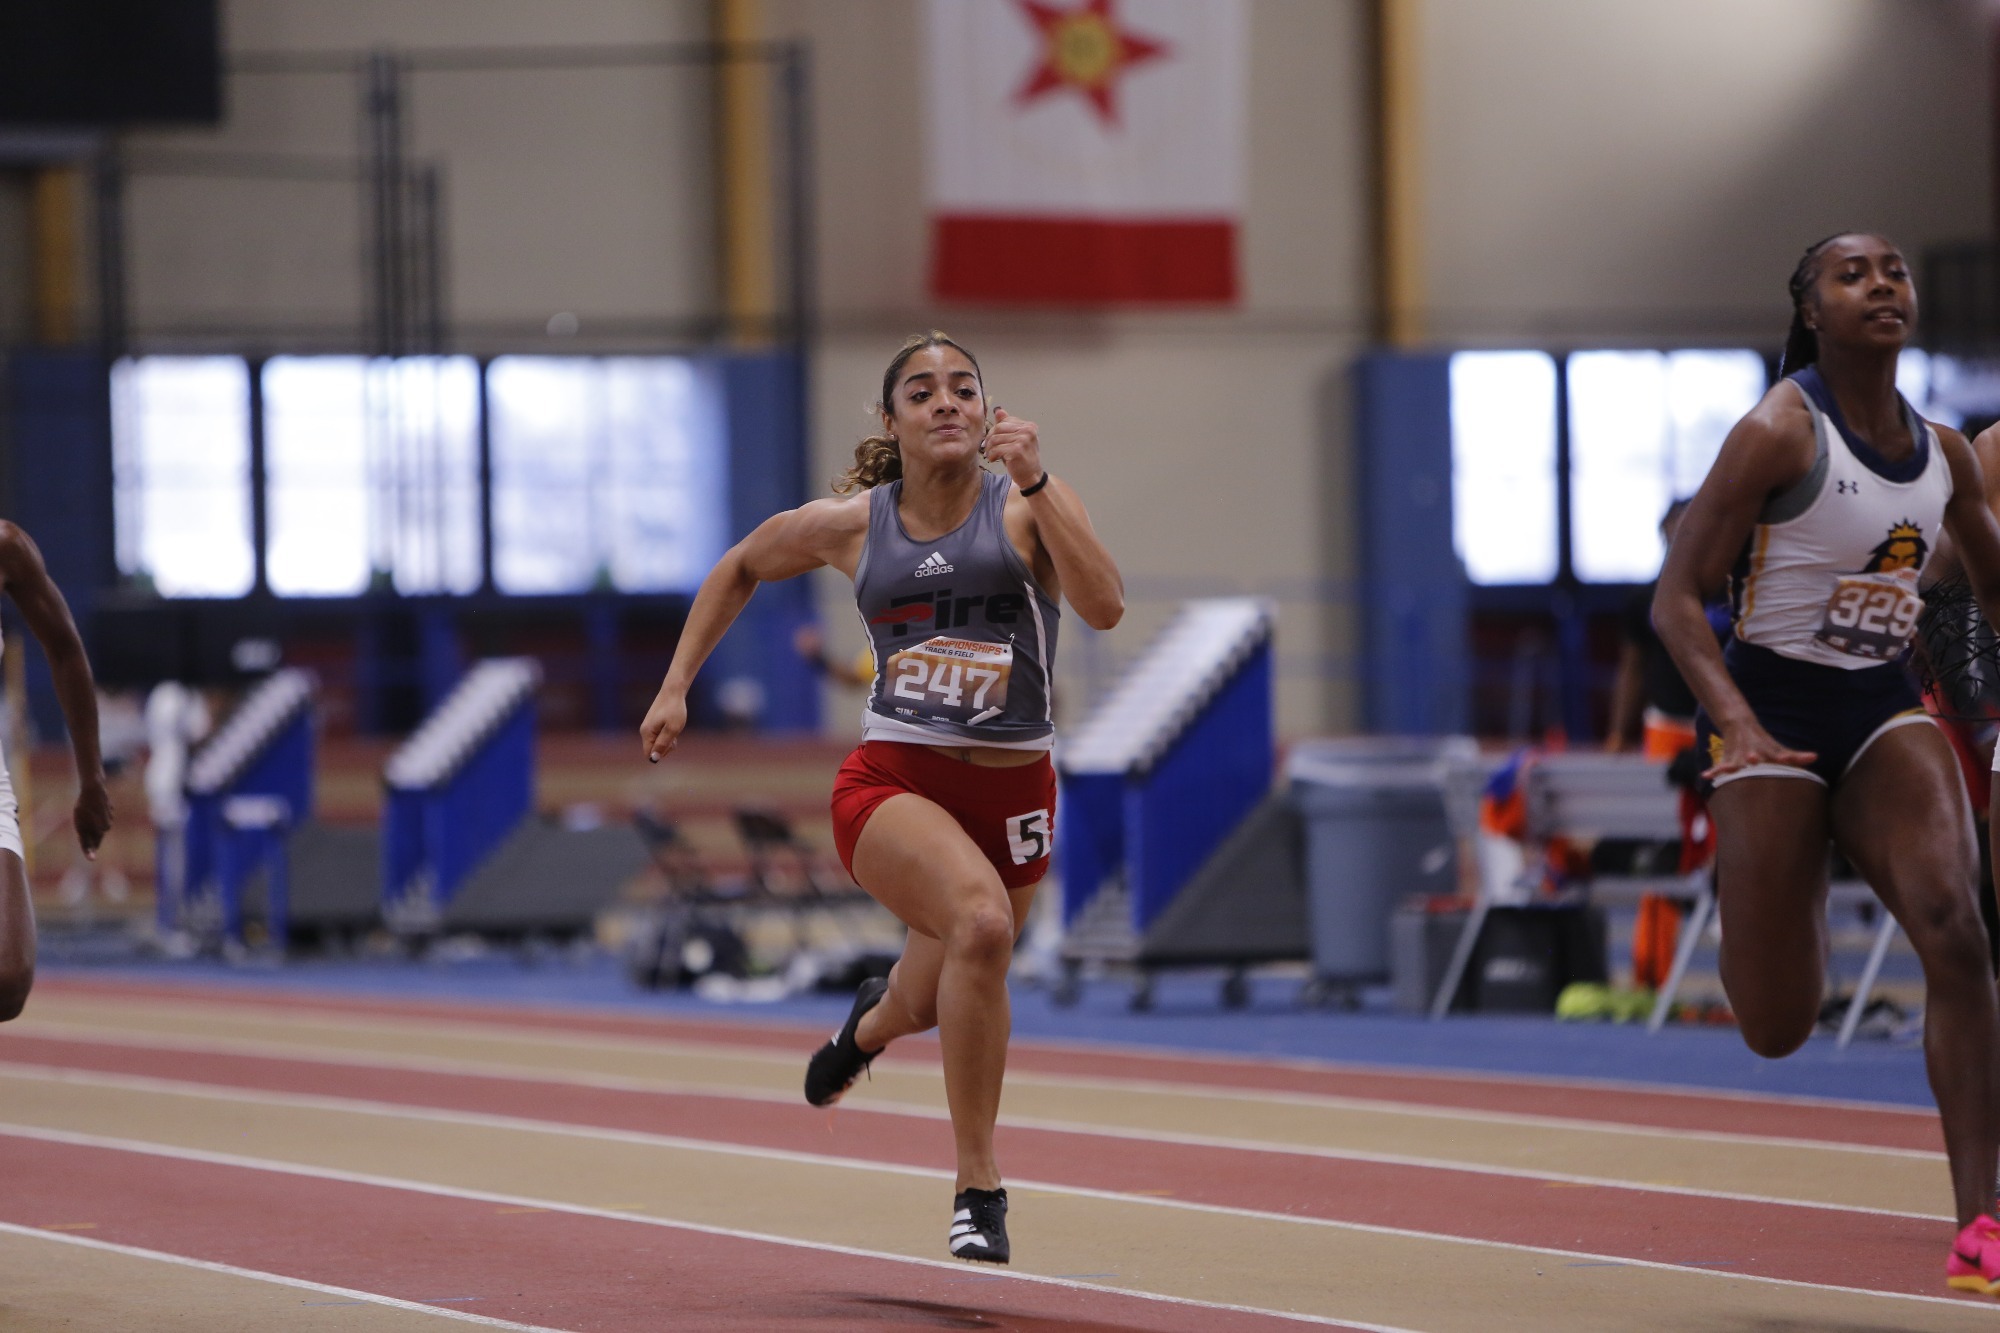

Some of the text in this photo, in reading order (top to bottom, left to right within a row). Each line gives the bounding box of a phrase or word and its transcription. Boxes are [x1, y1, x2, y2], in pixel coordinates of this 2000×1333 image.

[914, 563, 954, 577] adidas
[873, 588, 1026, 636] Fire
[1830, 588, 1920, 637] 329
[925, 639, 1002, 656] HAMPIONSHIPS
[925, 646, 947, 655] TRACK
[894, 657, 1001, 710] 247
[1020, 814, 1044, 862] 5
